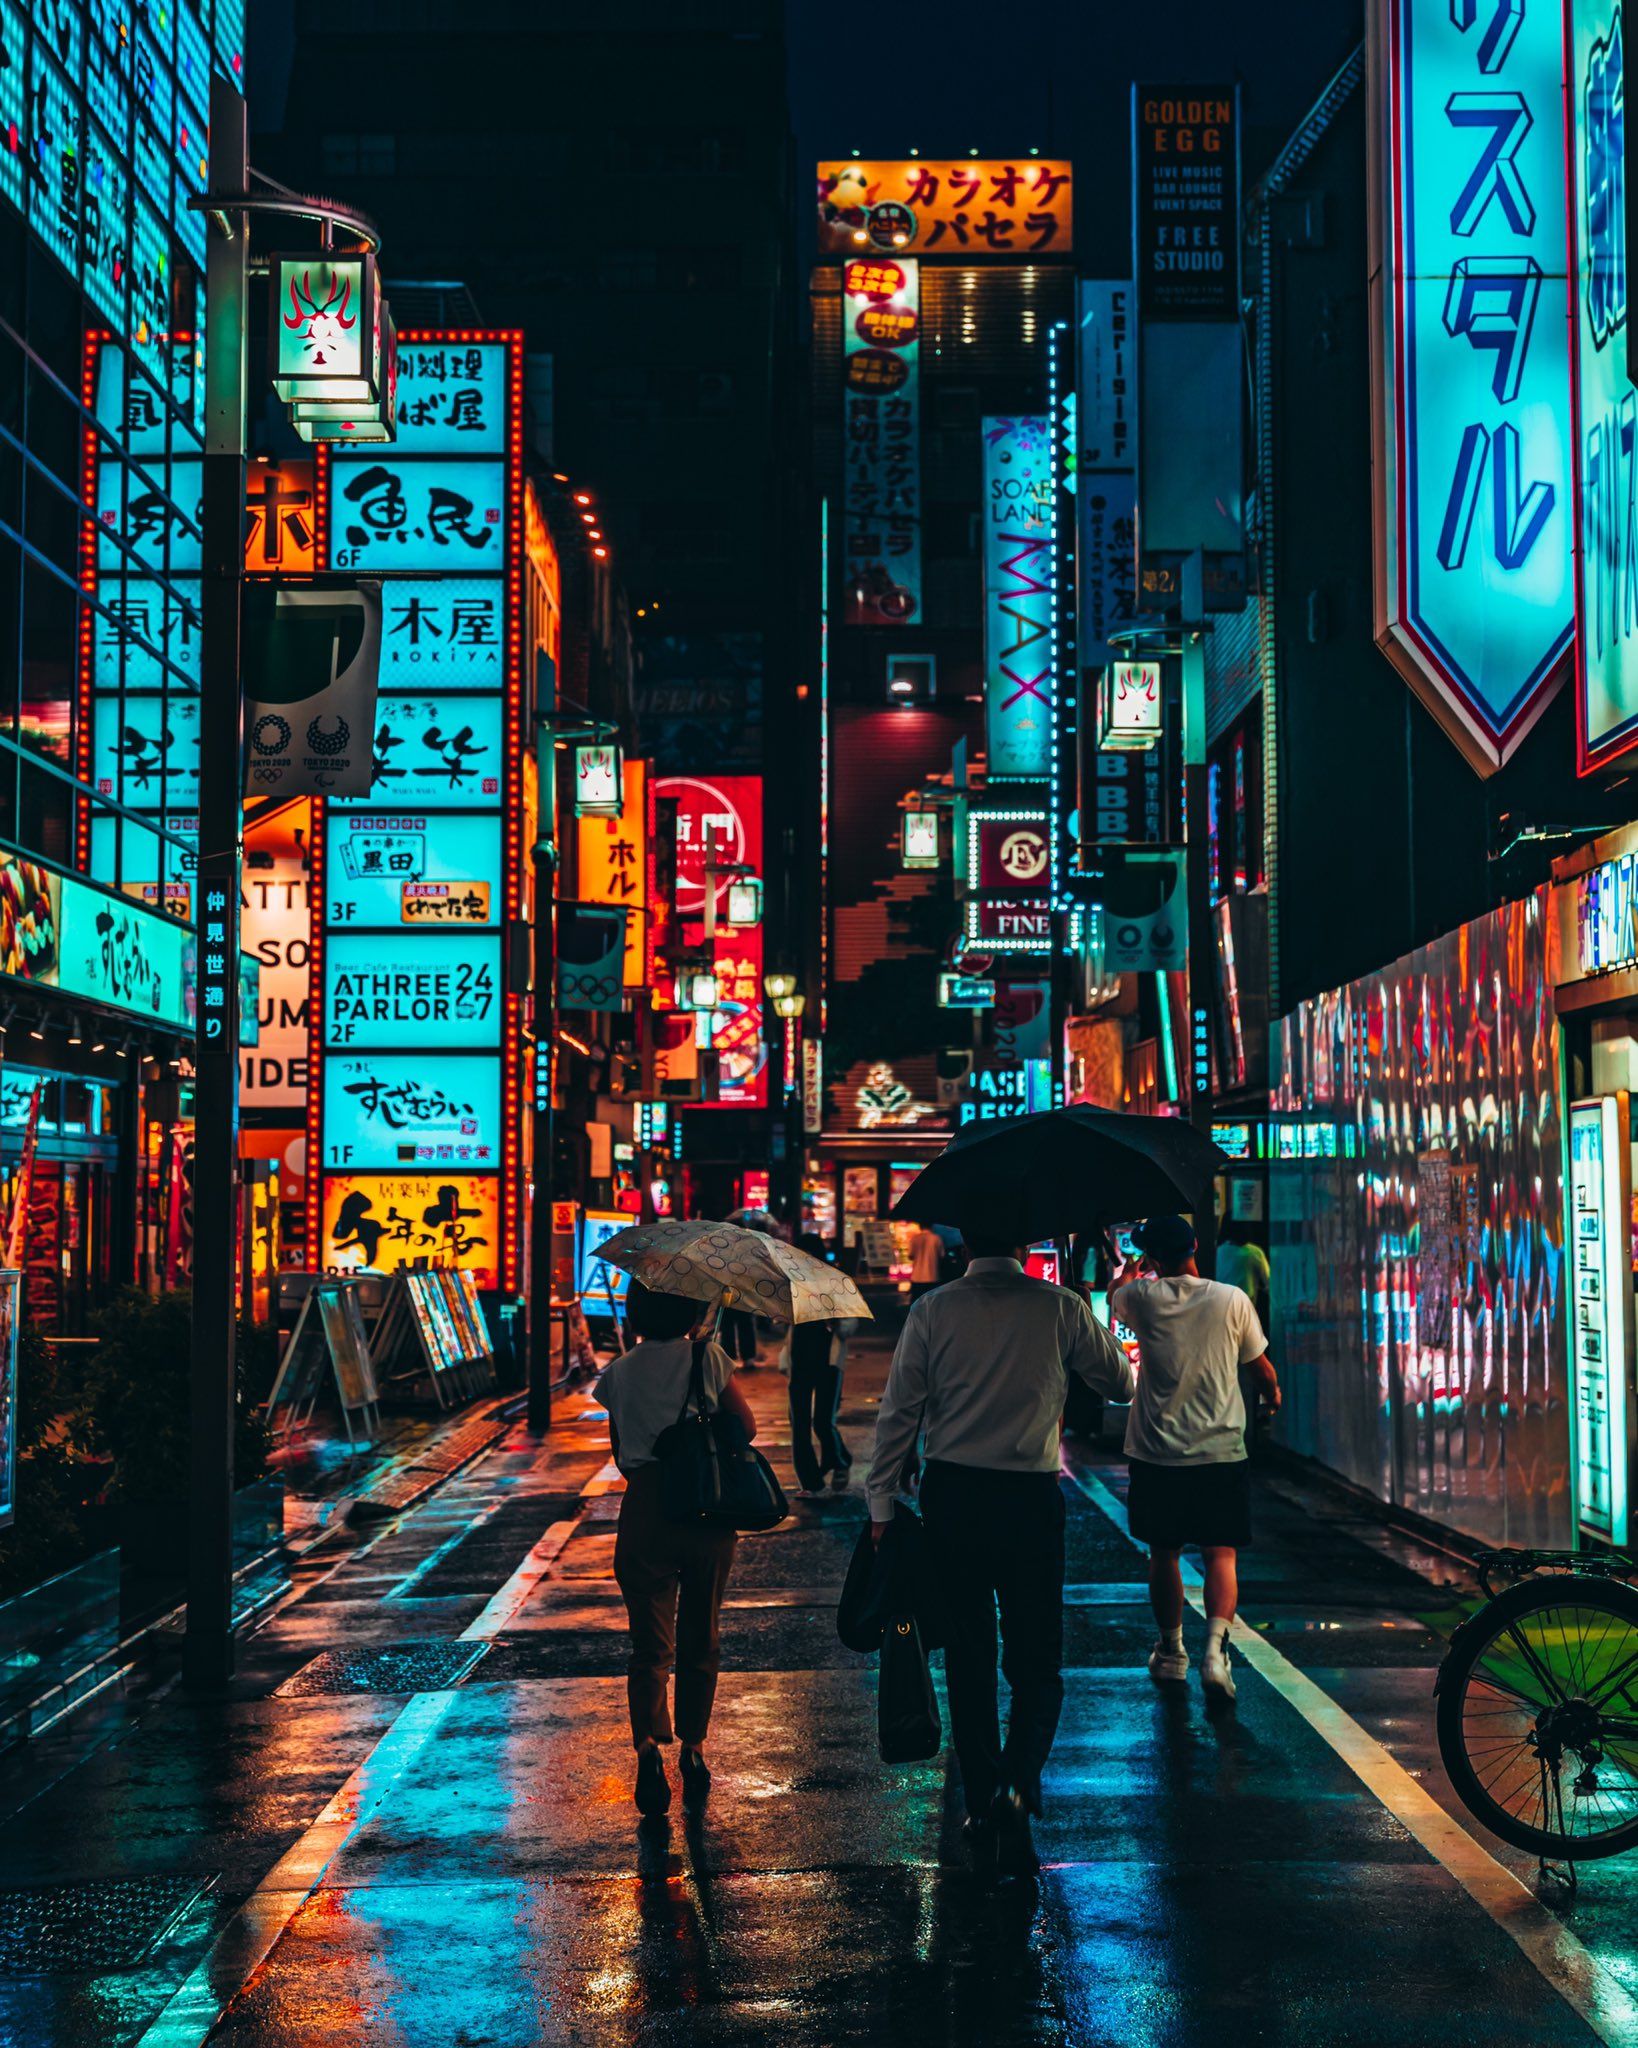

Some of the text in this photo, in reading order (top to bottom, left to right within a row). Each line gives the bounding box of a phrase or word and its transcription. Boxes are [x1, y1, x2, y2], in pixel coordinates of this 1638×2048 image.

[1145, 101, 1230, 123] GOLDEN
[1155, 129, 1220, 151] EGG
[1153, 167, 1222, 178] LIVE MUSIC
[906, 166, 1070, 208] カラオケ
[1154, 183, 1222, 193] BAR LOUNGE
[1154, 200, 1222, 210] EVENT SPACE
[924, 212, 1059, 250] パセラ
[1158, 226, 1218, 246] FREE
[1154, 252, 1224, 271] STUDIO
[343, 466, 492, 549] 魚民
[336, 549, 361, 567] 6F
[998, 532, 1051, 712] MAX
[272, 759, 291, 767] 2020
[303, 758, 350, 768] TOKYO 2020
[362, 850, 413, 873] 黒田
[332, 902, 357, 921] 3F
[205, 891, 225, 1038] 仲見世通り
[334, 974, 450, 996] ATHREE
[334, 999, 450, 1020] PARLOR
[331, 1024, 356, 1042] 2F
[239, 1058, 308, 1089] IDE
[330, 1146, 354, 1164] 1F
